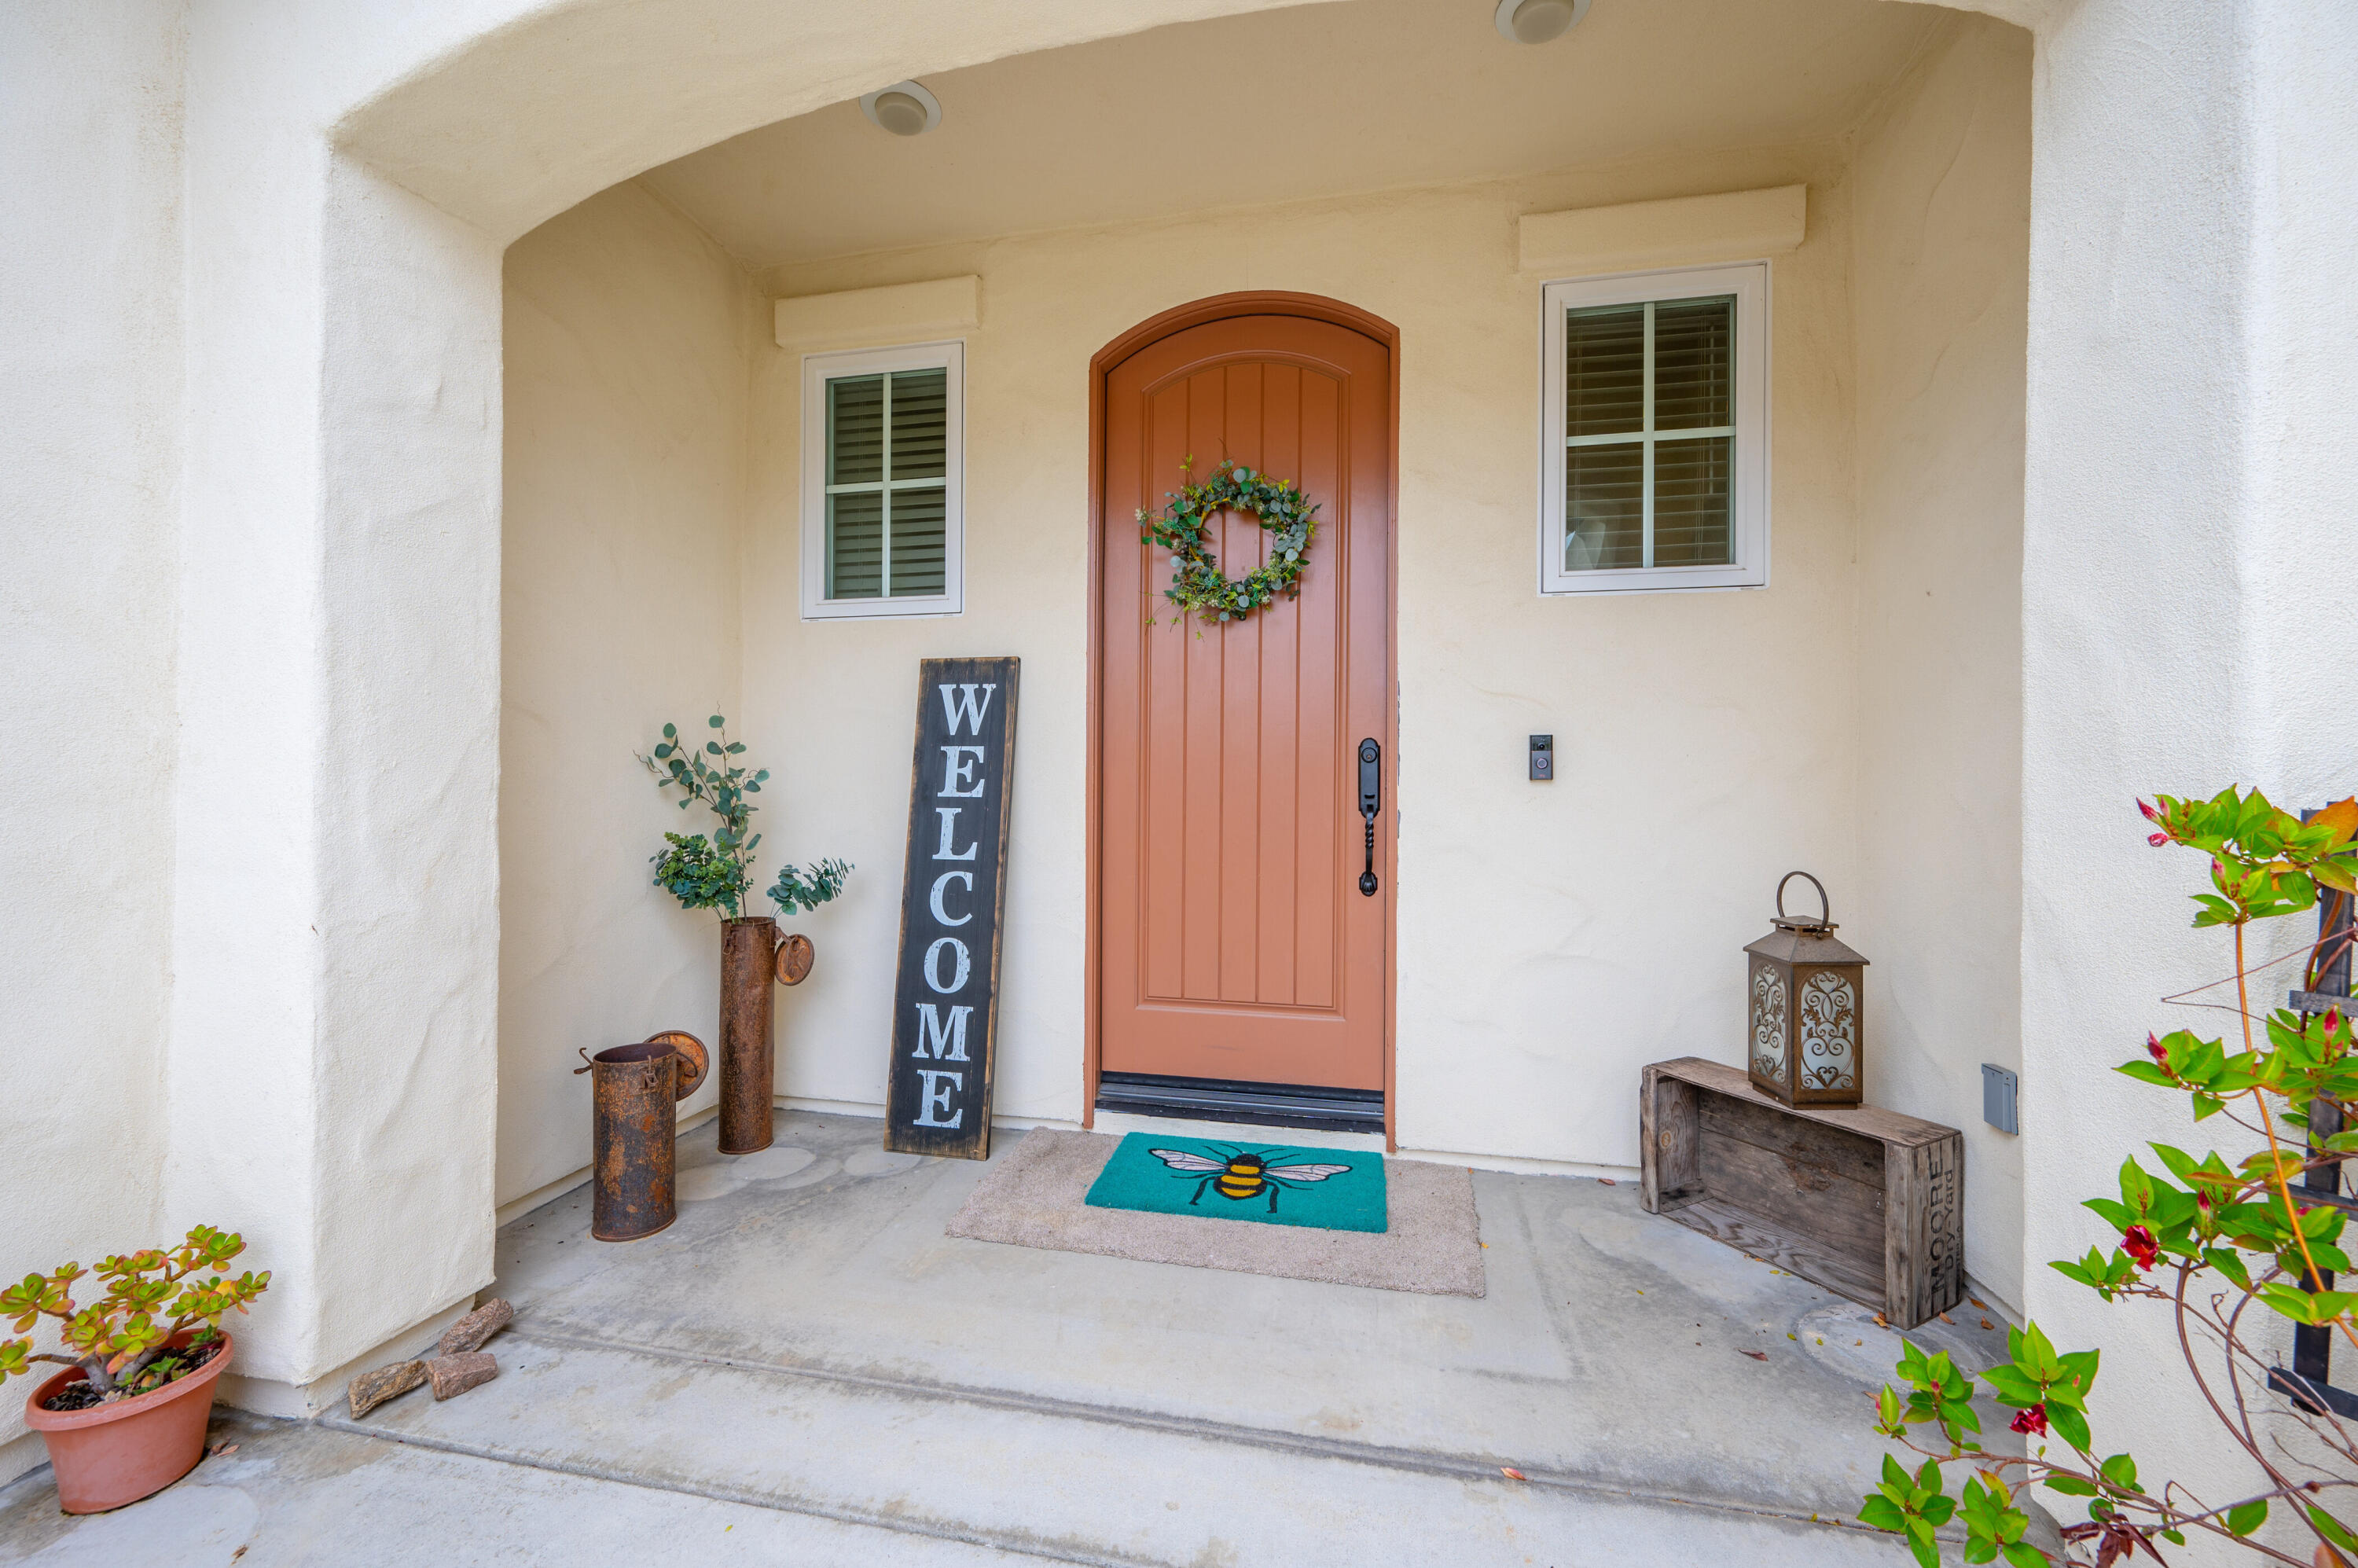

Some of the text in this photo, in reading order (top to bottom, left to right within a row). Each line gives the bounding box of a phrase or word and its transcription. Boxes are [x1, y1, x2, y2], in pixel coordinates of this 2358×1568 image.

[912, 683, 996, 1129] WELCOME
[1930, 1158, 1945, 1295] MOORE
[1944, 1169, 1955, 1270] Dry-Yard
